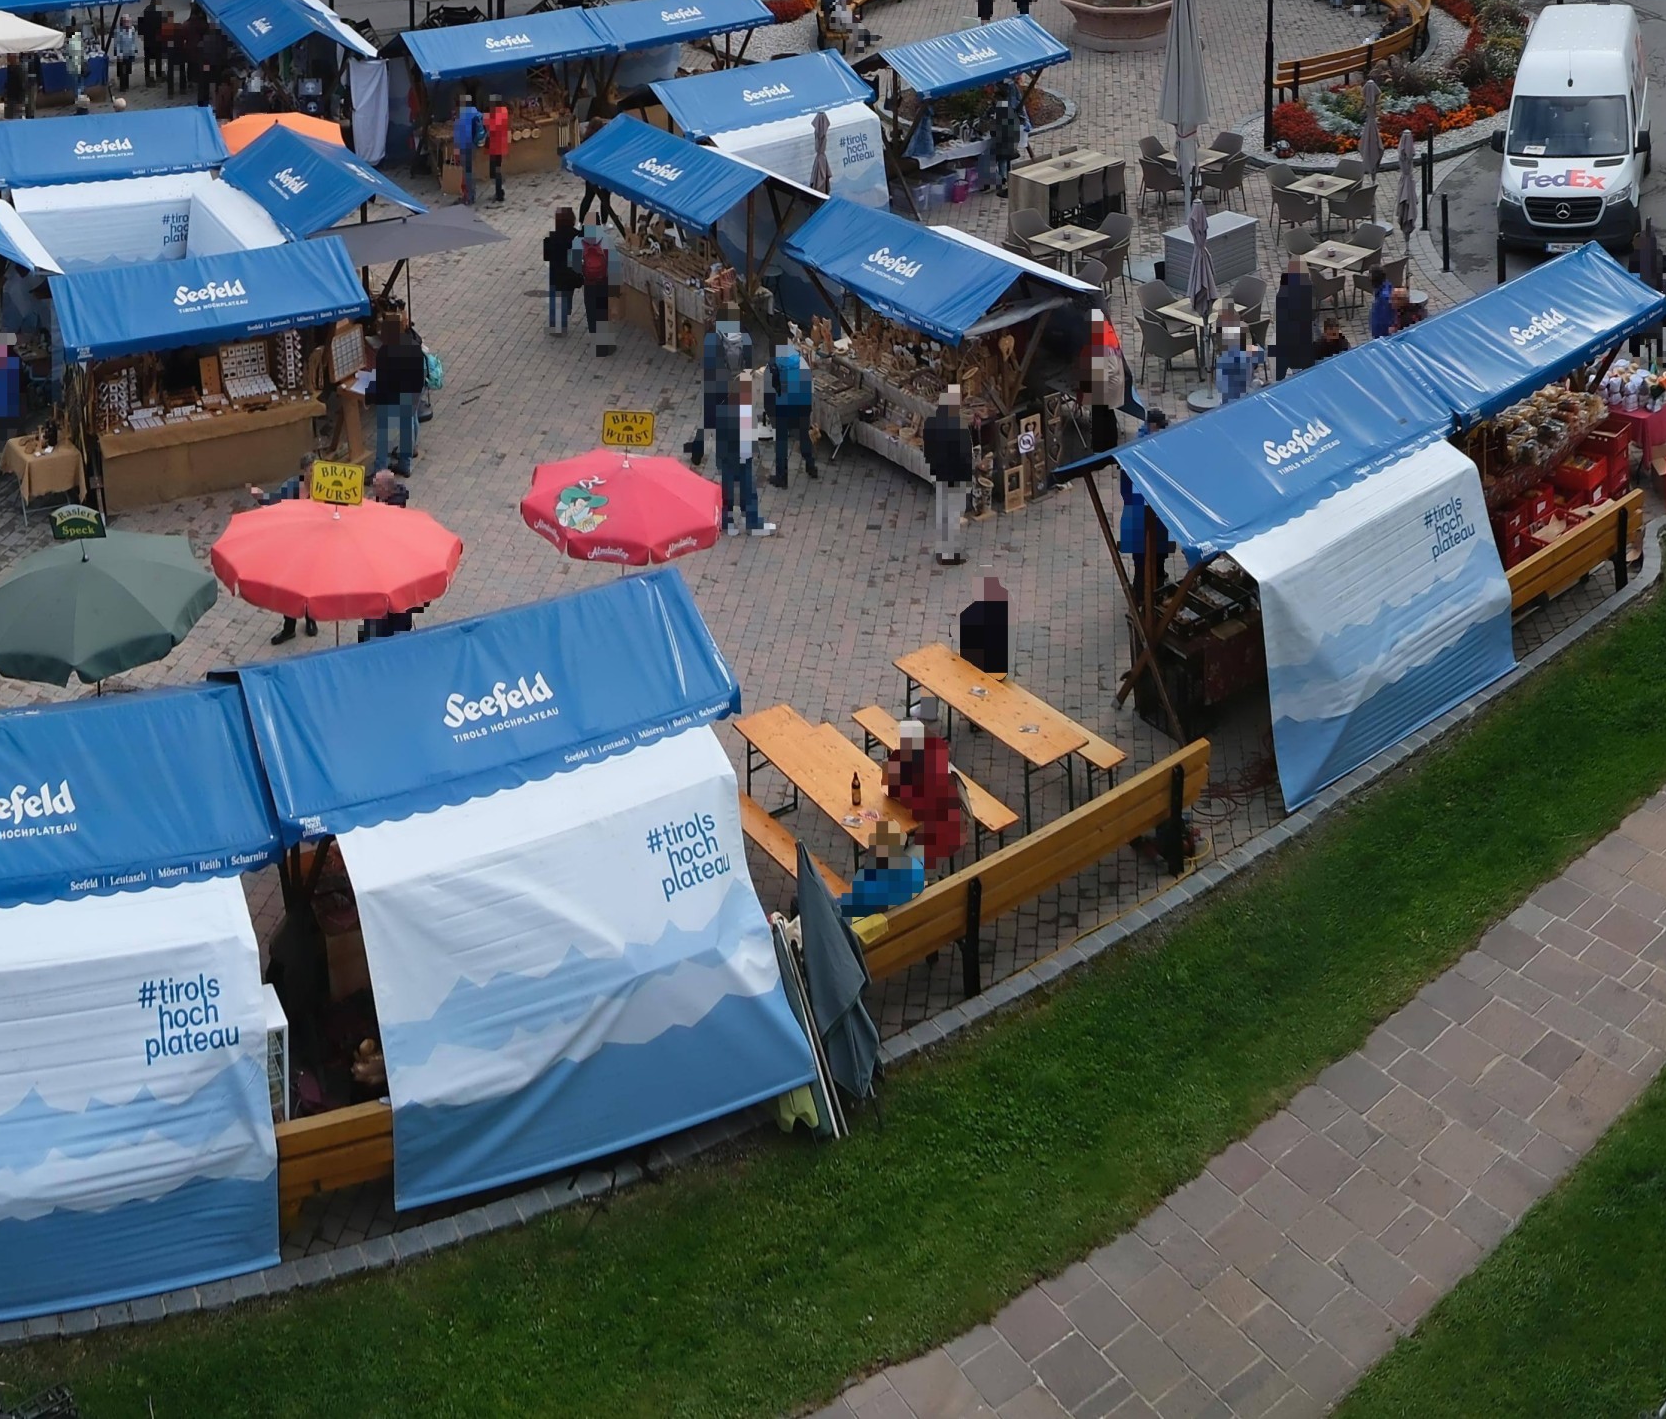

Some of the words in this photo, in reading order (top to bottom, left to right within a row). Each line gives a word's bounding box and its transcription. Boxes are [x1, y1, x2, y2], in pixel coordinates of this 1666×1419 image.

[661, 6, 702, 22] Seefeld
[485, 34, 531, 50] Seefeld
[743, 83, 791, 102] Seefeld
[74, 137, 133, 155] Seefeld
[839, 132, 868, 148] #tirols
[846, 141, 867, 153] hoch
[638, 157, 683, 181] Seefeld
[843, 150, 875, 168] plateau
[1521, 169, 1606, 191] FedEx
[868, 247, 923, 278] Seefeld
[173, 279, 246, 306] Seefeld
[178, 306, 202, 314] TIROLS
[1509, 308, 1567, 347] Seefeld
[612, 413, 647, 426] BRAT
[606, 428, 650, 444] WURST
[1263, 416, 1332, 466] Seefeld
[321, 465, 357, 481] BRAT
[315, 481, 358, 501] WURST
[1423, 496, 1462, 529] #tirols
[1434, 511, 1464, 537] hoch
[62, 525, 95, 536] Speck
[1431, 523, 1476, 562] plateau
[443, 671, 554, 728] Seefeld
[453, 728, 488, 744] TIROLS
[491, 707, 559, 734] HOCHPLATEAU
[564, 749, 590, 764] Seefeld
[598, 736, 631, 754] Leutasch
[638, 725, 666, 740] Mösern
[673, 715, 693, 729] Reith
[0, 822, 78, 841] HOCHPLATEAU
[647, 812, 715, 855] #tirols
[666, 831, 719, 868] hoch
[70, 877, 98, 892] Seefeld
[110, 871, 147, 886] Leutasch
[158, 864, 189, 879] Mösern
[199, 858, 222, 872] Reith
[230, 850, 269, 867] Scharnitz
[661, 852, 731, 903] plateau
[139, 973, 221, 1009] #tirols
[158, 995, 219, 1030] hoch
[145, 1025, 241, 1066] plateau
